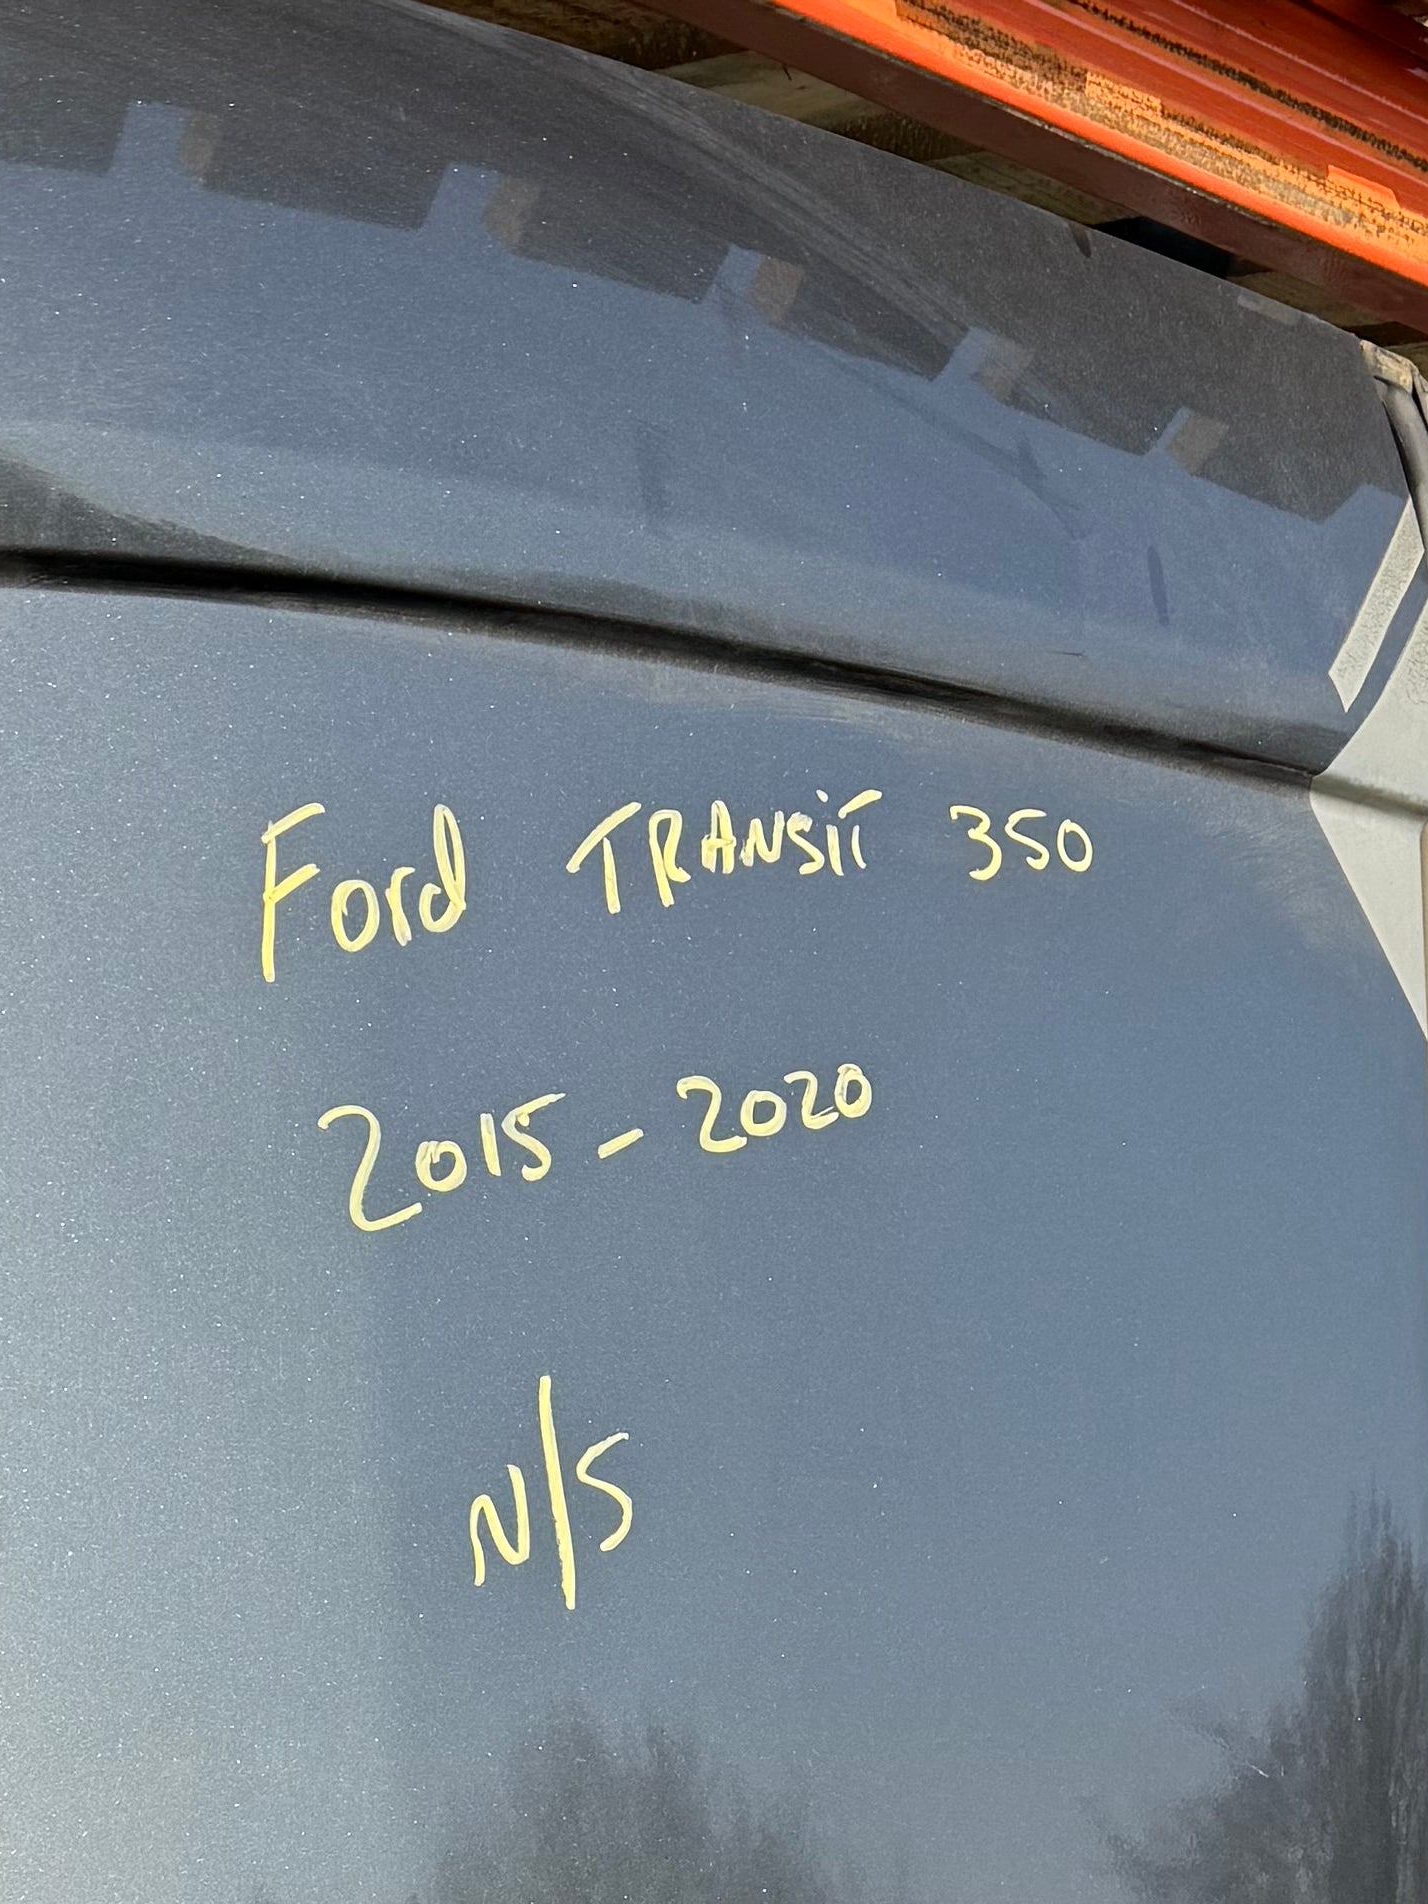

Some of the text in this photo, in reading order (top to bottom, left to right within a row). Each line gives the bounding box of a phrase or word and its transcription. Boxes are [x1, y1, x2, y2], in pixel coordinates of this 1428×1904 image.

[261, 804, 467, 983] Ford
[949, 805, 1094, 881] 350
[318, 1092, 566, 1231] 2015
[676, 1064, 873, 1153] 2020
[469, 1375, 633, 1610] N/S
